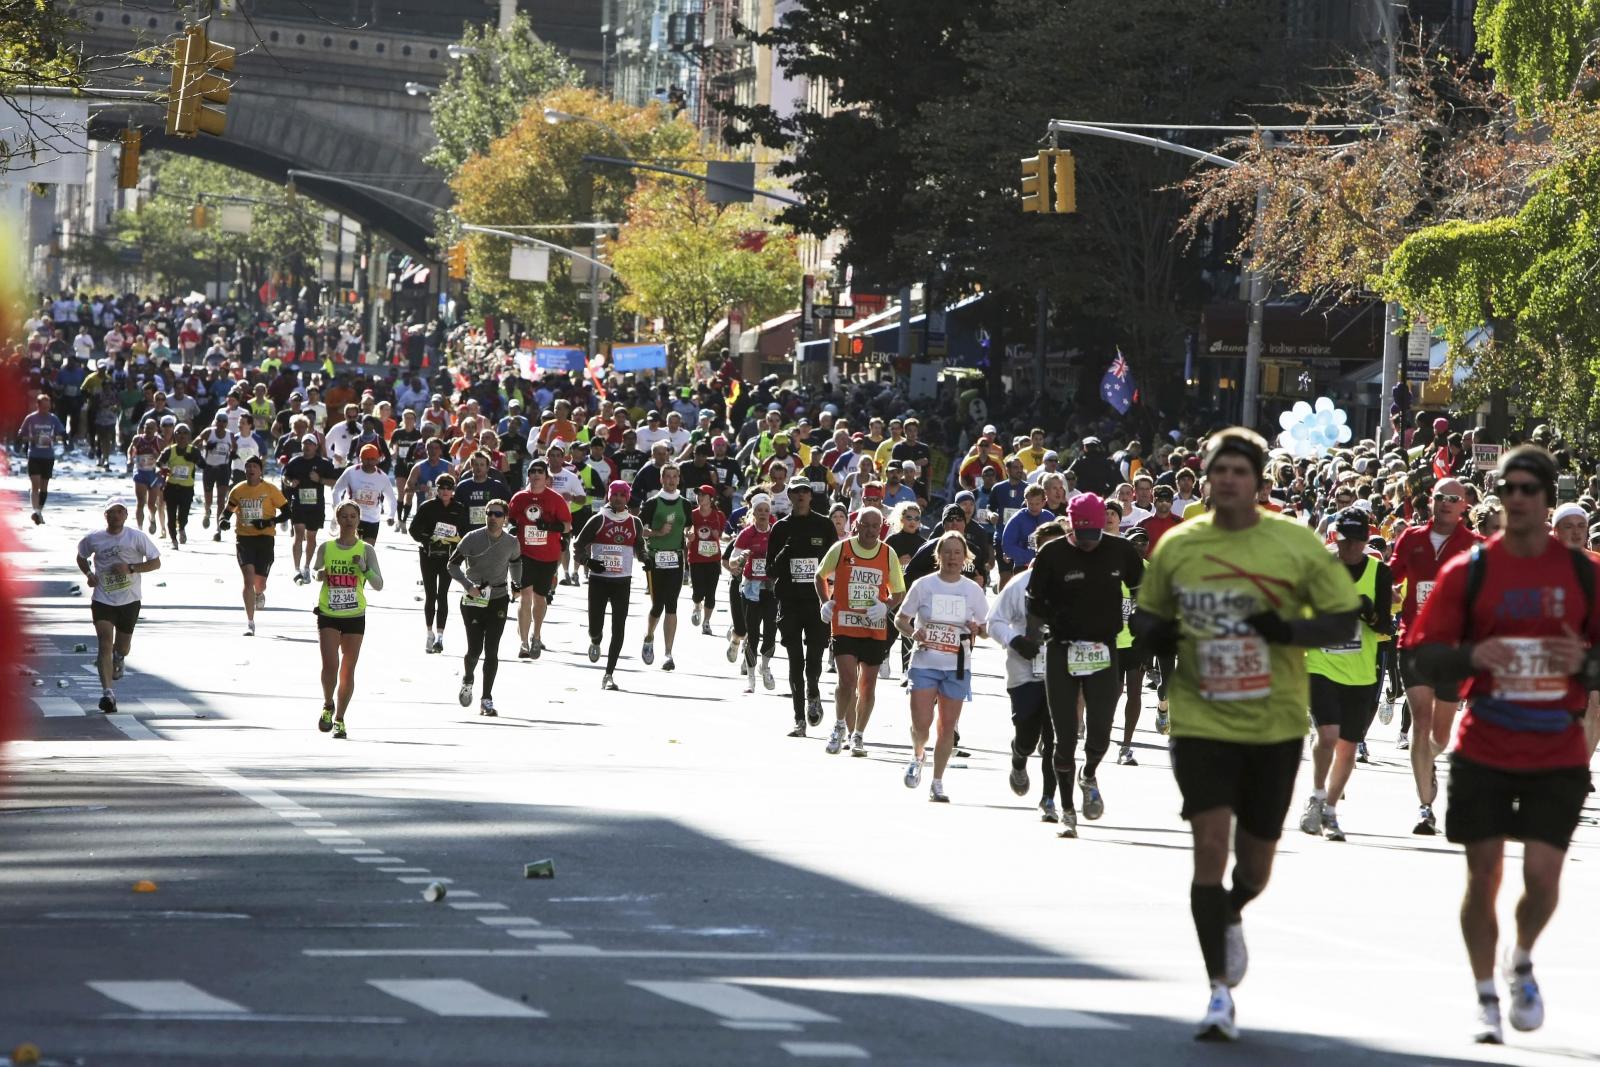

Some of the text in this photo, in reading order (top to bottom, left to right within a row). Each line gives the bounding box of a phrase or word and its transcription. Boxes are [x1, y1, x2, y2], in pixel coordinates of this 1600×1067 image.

[1475, 453, 1497, 462] TEAM
[605, 525, 632, 539] ITALIA
[327, 575, 357, 587] KELLY
[853, 569, 881, 585] MERV
[332, 594, 355, 603] 22-345
[935, 598, 961, 617] SUE
[845, 614, 864, 626] FOR
[928, 630, 956, 645] 15-253
[1074, 651, 1105, 662] 21-691
